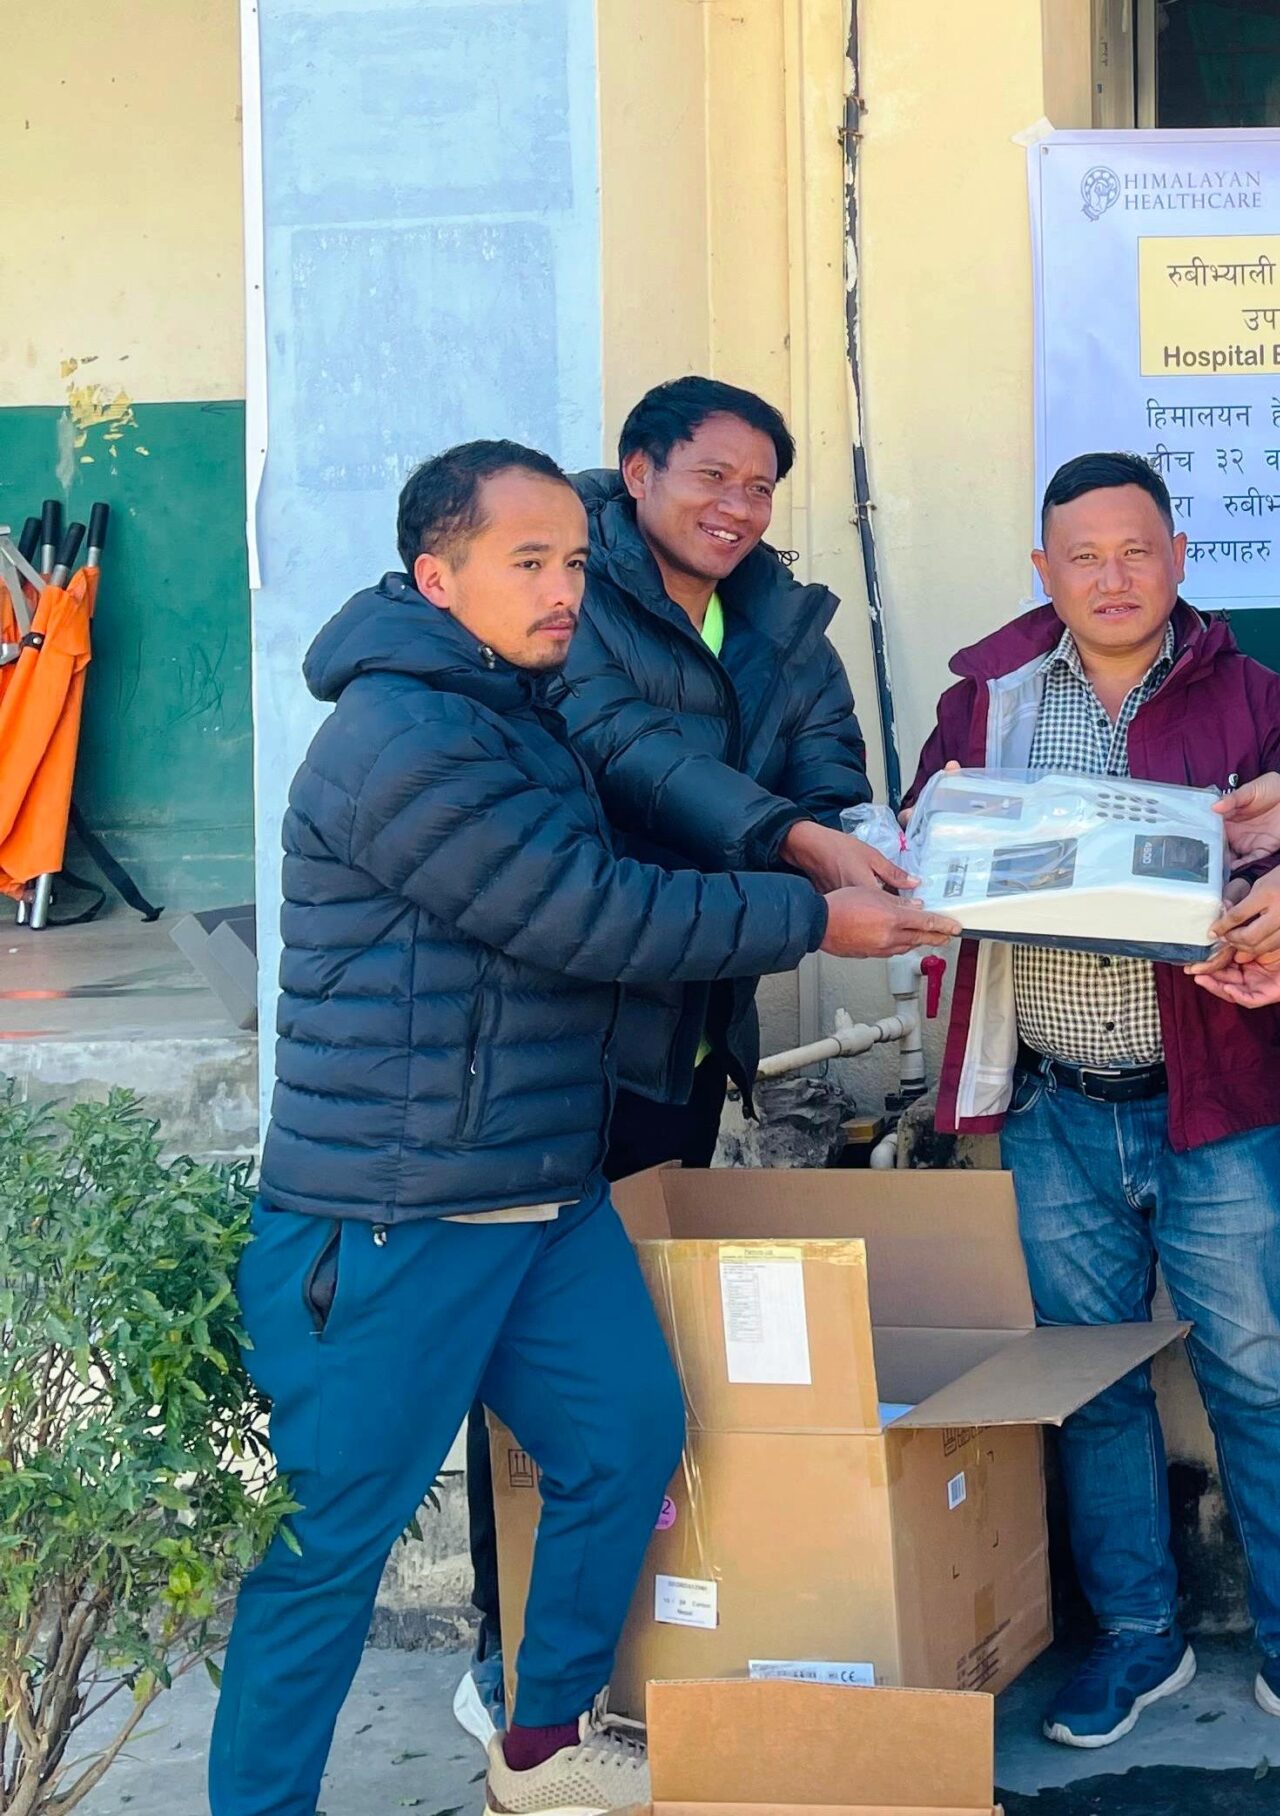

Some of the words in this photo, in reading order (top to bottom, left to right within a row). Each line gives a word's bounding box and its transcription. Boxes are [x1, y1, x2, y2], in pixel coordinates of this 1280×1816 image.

[1124, 171, 1261, 190] HIMALAYAN
[1124, 192, 1262, 210] HEALTHCARE
[1166, 255, 1276, 287] रुबीभ्याली
[1163, 343, 1265, 372] Hospital
[1146, 398, 1252, 429] हिमालयन
[1216, 448, 1245, 474] ३२
[1187, 539, 1272, 563] करणहरु
